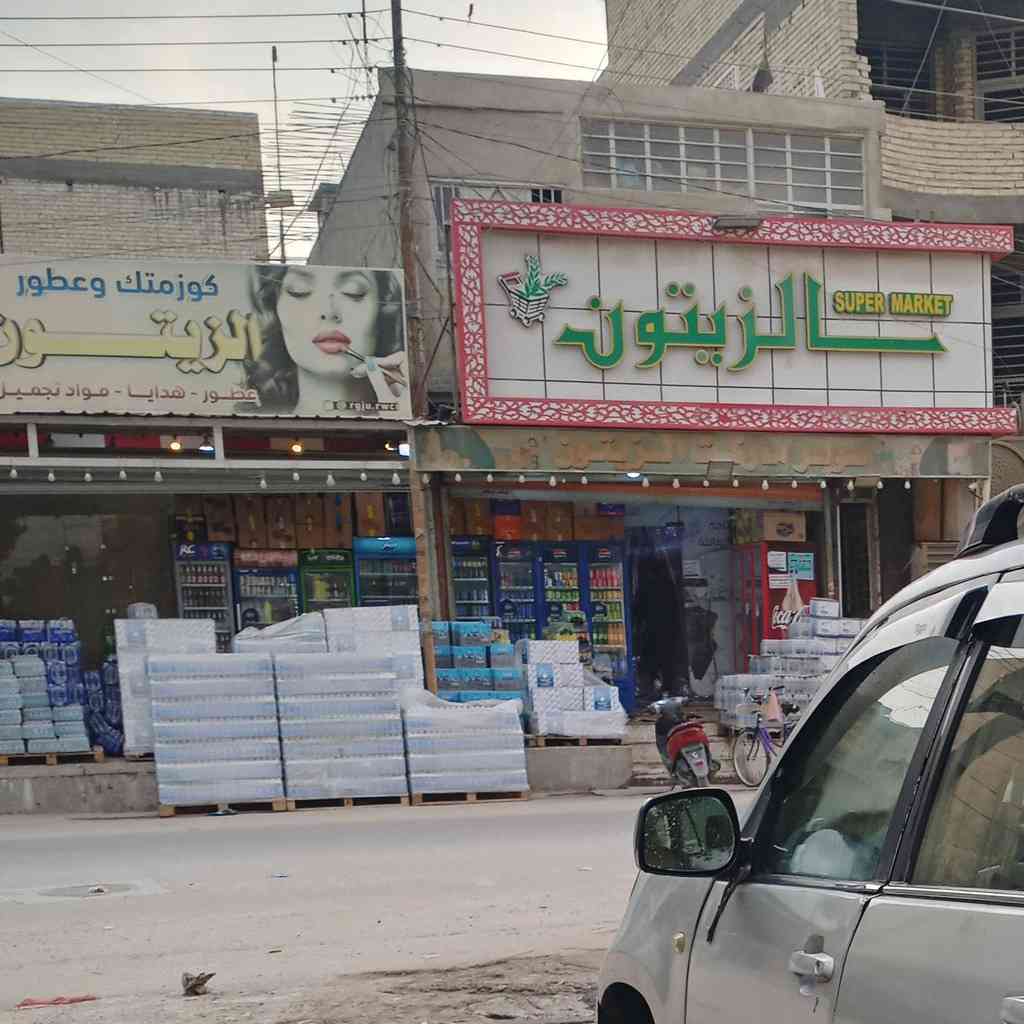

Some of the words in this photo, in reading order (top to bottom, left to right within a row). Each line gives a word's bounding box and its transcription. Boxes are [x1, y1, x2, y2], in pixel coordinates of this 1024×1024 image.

[15, 267, 107, 298] وعطور
[115, 270, 220, 301] كوزمتك
[833, 290, 886, 314] SUPER
[889, 292, 954, 317] MARKET
[554, 271, 950, 373] الزيتون
[64, 383, 110, 402] مواد
[128, 383, 186, 402] هدايا
